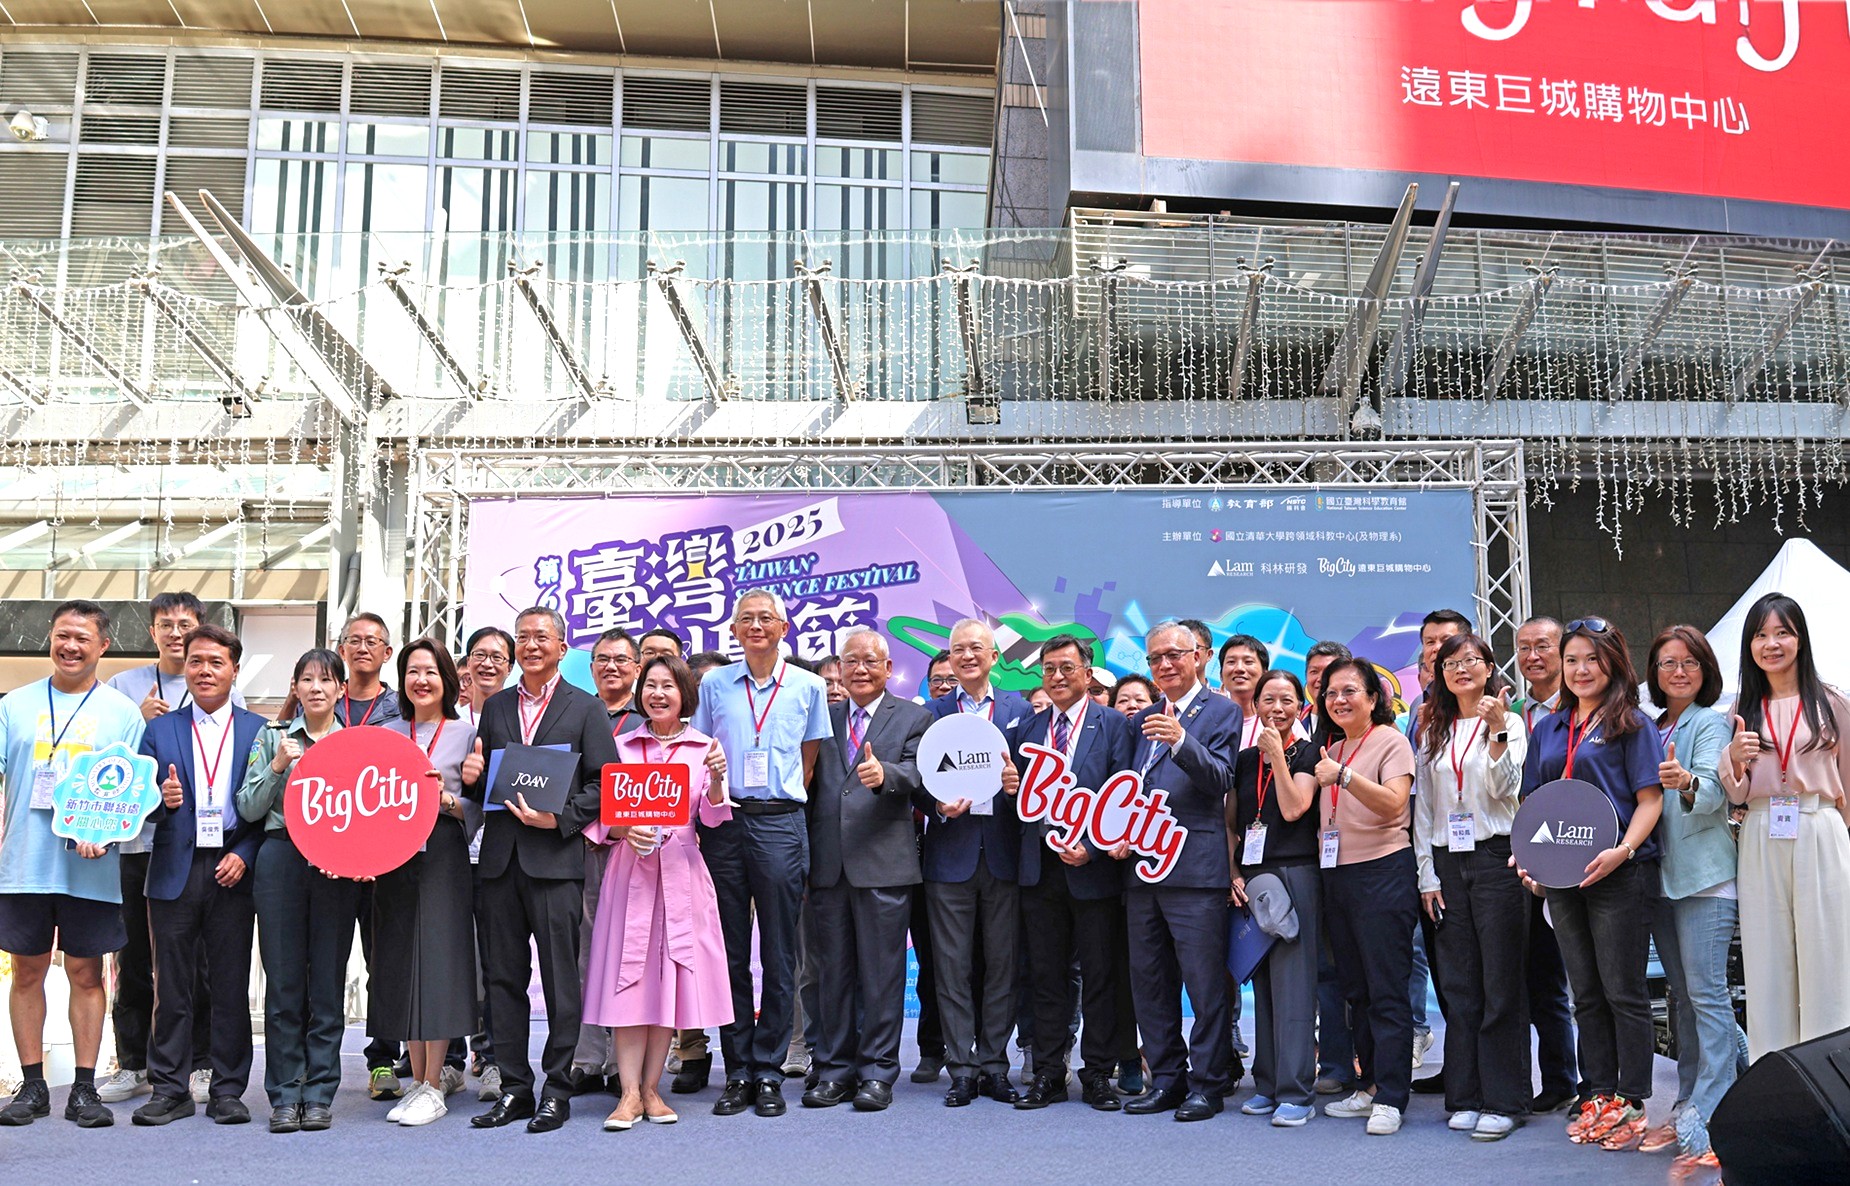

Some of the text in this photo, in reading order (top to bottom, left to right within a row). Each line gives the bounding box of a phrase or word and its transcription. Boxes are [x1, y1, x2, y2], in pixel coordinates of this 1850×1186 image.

[1400, 65, 1750, 135] 遠東巨城購物中心
[1162, 498, 1202, 509] 指導單位
[1226, 498, 1274, 510] 教育部
[743, 507, 823, 556] 2025
[1162, 531, 1202, 542] 主辦單位
[734, 555, 817, 582] TAIWAN
[1226, 559, 1254, 572] Lam
[1260, 562, 1308, 575] 科林研發
[1316, 557, 1356, 577] BigCity
[1357, 563, 1431, 573] 遠東巨城購物中心
[571, 534, 729, 639] 臺灣
[735, 563, 917, 599] SENCE FESTIVAL
[957, 750, 991, 765] Lam
[511, 772, 549, 788] JOAN
[610, 770, 682, 808] BigCity
[291, 765, 418, 833] BigCity
[1021, 747, 1184, 879] BigCity
[1556, 820, 1595, 840] Lam
[1555, 838, 1593, 847] RESEARCH
